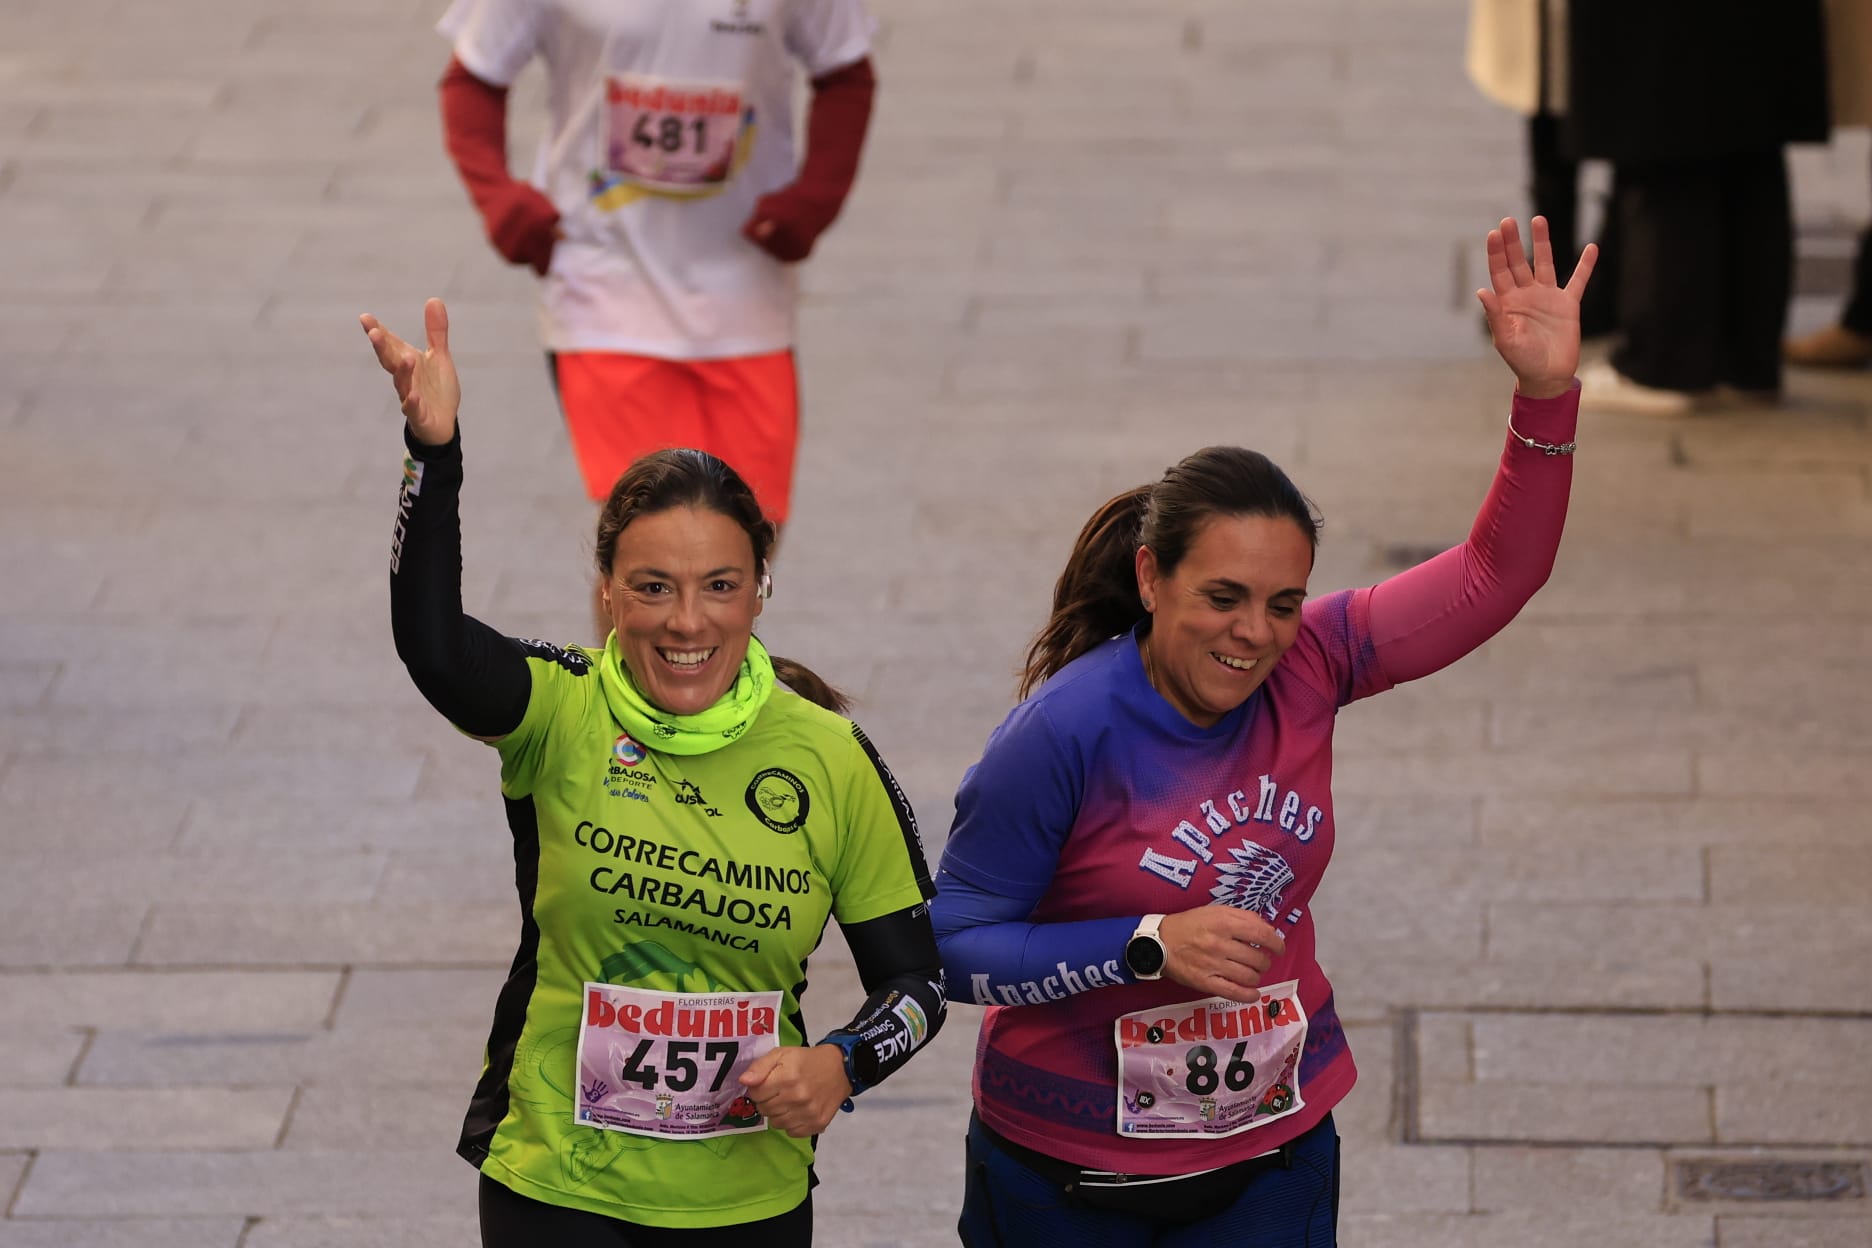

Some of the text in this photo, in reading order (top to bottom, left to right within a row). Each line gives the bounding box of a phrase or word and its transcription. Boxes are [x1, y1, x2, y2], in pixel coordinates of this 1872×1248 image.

[633, 115, 708, 155] 481
[611, 776, 653, 791] DEPORTE
[1137, 773, 1324, 890] Apaches
[574, 820, 812, 896] CORRECAMINOS
[589, 865, 793, 932] CARBAJOSA
[613, 907, 760, 955] SALAMANCA
[587, 991, 775, 1038] bedunia
[678, 995, 735, 1007] FLORISTERÍAS
[1120, 994, 1301, 1049] bedunia
[622, 1039, 740, 1093] 457
[1185, 1041, 1256, 1096] 86
[675, 1111, 720, 1121] de Salamanca
[1218, 1111, 1227, 1121] de
